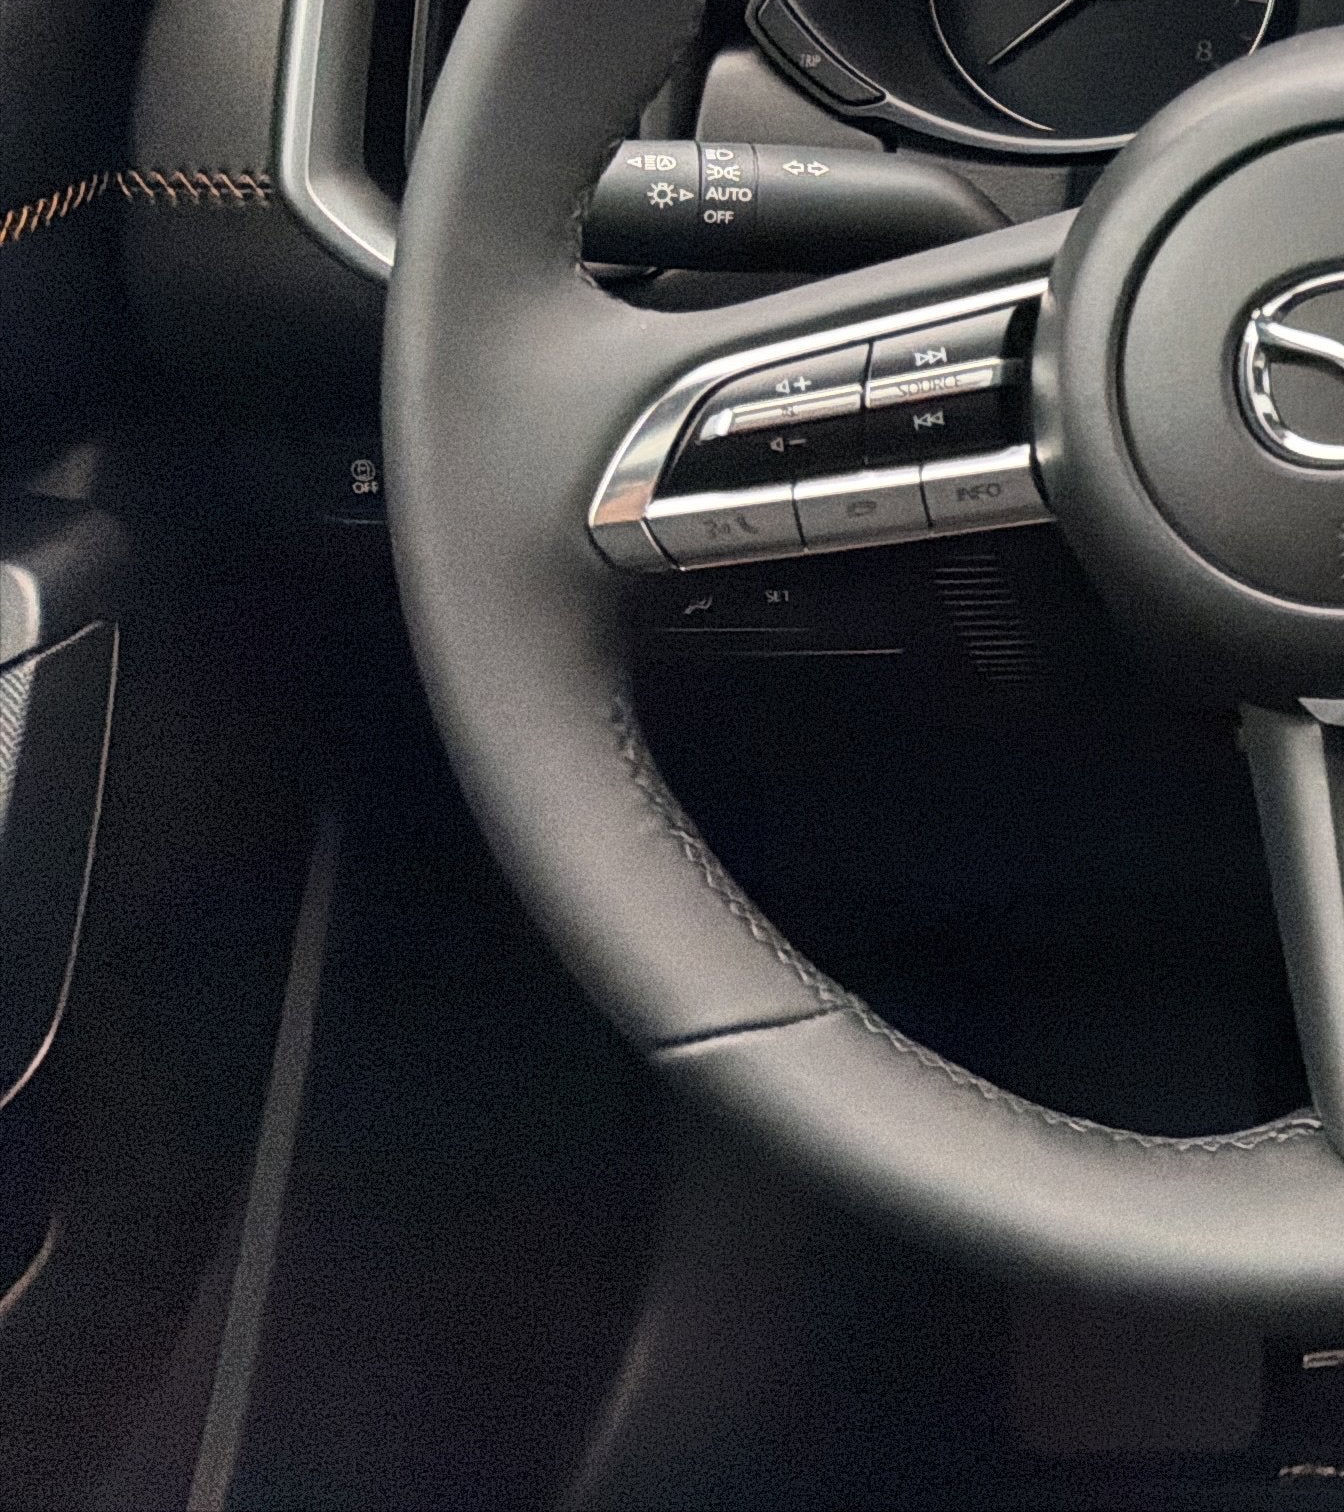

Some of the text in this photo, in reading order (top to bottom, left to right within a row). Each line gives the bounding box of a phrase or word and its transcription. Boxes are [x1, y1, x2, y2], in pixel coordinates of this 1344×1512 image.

[1196, 39, 1213, 61] 8
[705, 187, 753, 202] AUTO
[703, 209, 735, 225] OFF
[896, 375, 961, 397] SOURCE
[352, 481, 379, 495] OFF
[764, 589, 790, 603] SET
